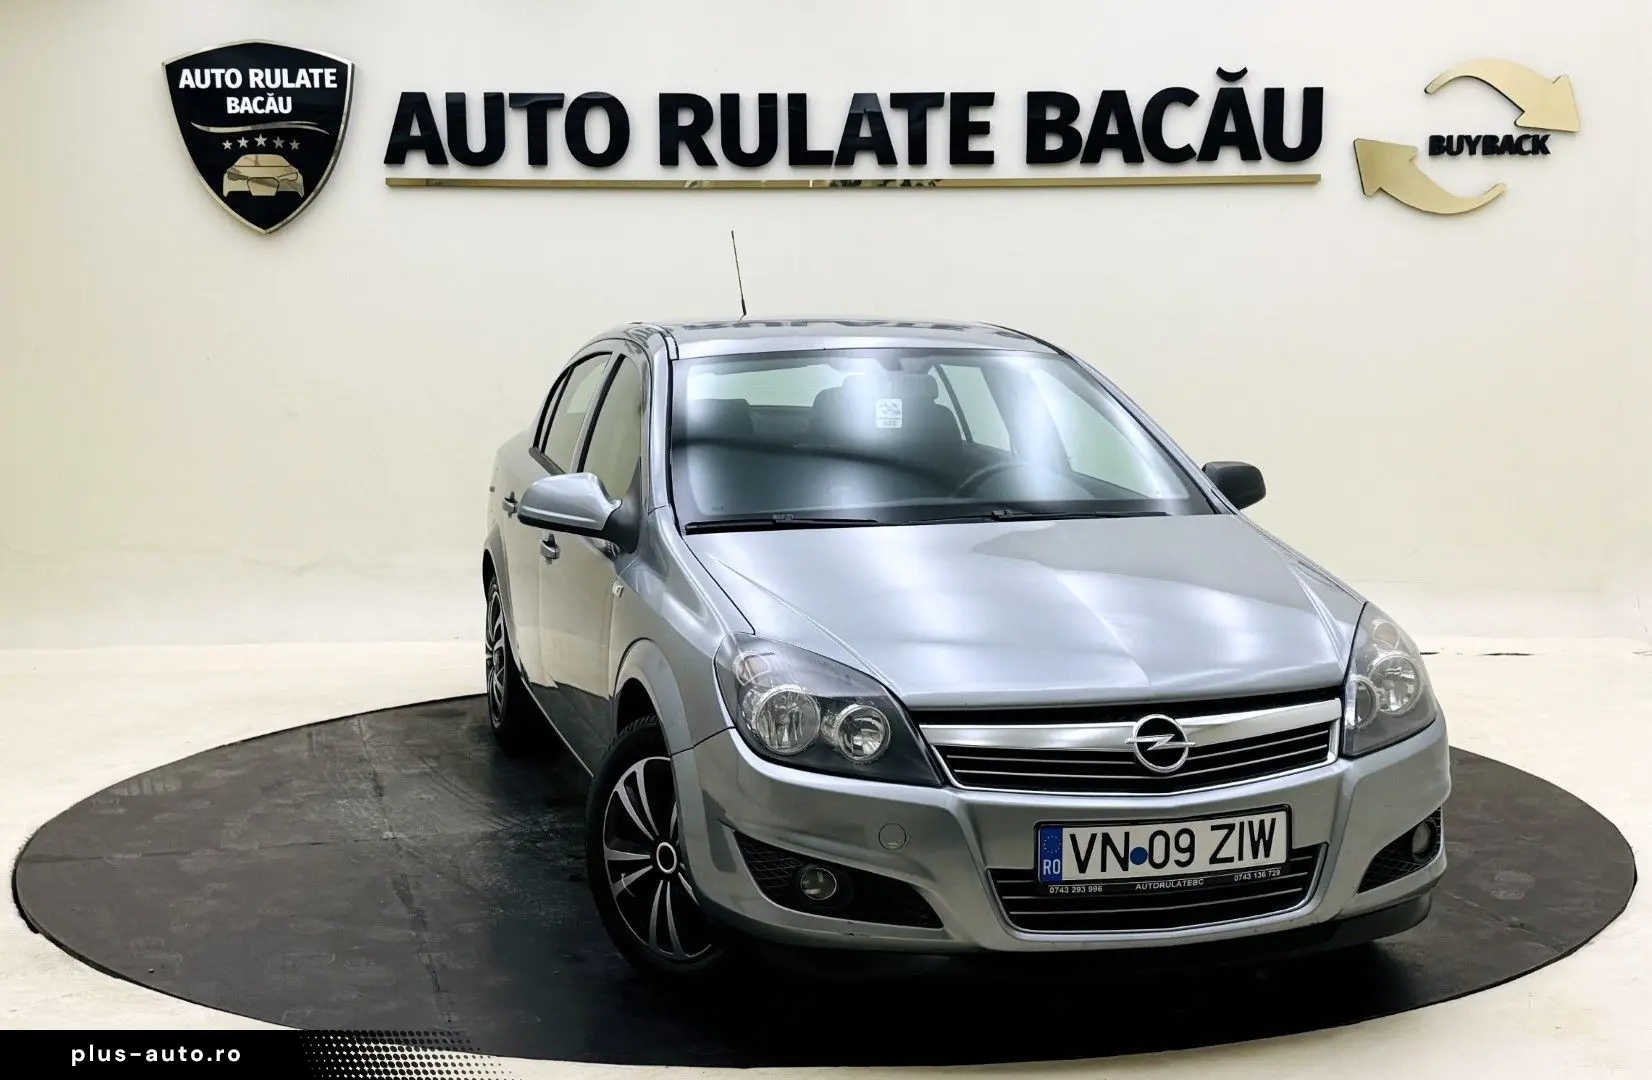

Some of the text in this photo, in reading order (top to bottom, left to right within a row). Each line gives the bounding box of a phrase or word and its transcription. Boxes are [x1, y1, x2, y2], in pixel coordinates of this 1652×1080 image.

[179, 68, 338, 89] AUTO RULATE
[226, 92, 292, 115] BACĂU
[384, 65, 1325, 168] AUTO RULATE BACĂU
[1428, 133, 1550, 157] BUYBACK
[1069, 817, 1277, 874] VN 09 ZIW
[1043, 858, 1061, 876] RO
[1135, 878, 1204, 890] AUTORULATEBC
[1234, 874, 1251, 882] 0743
[1049, 886, 1103, 894] 0743 293 996
